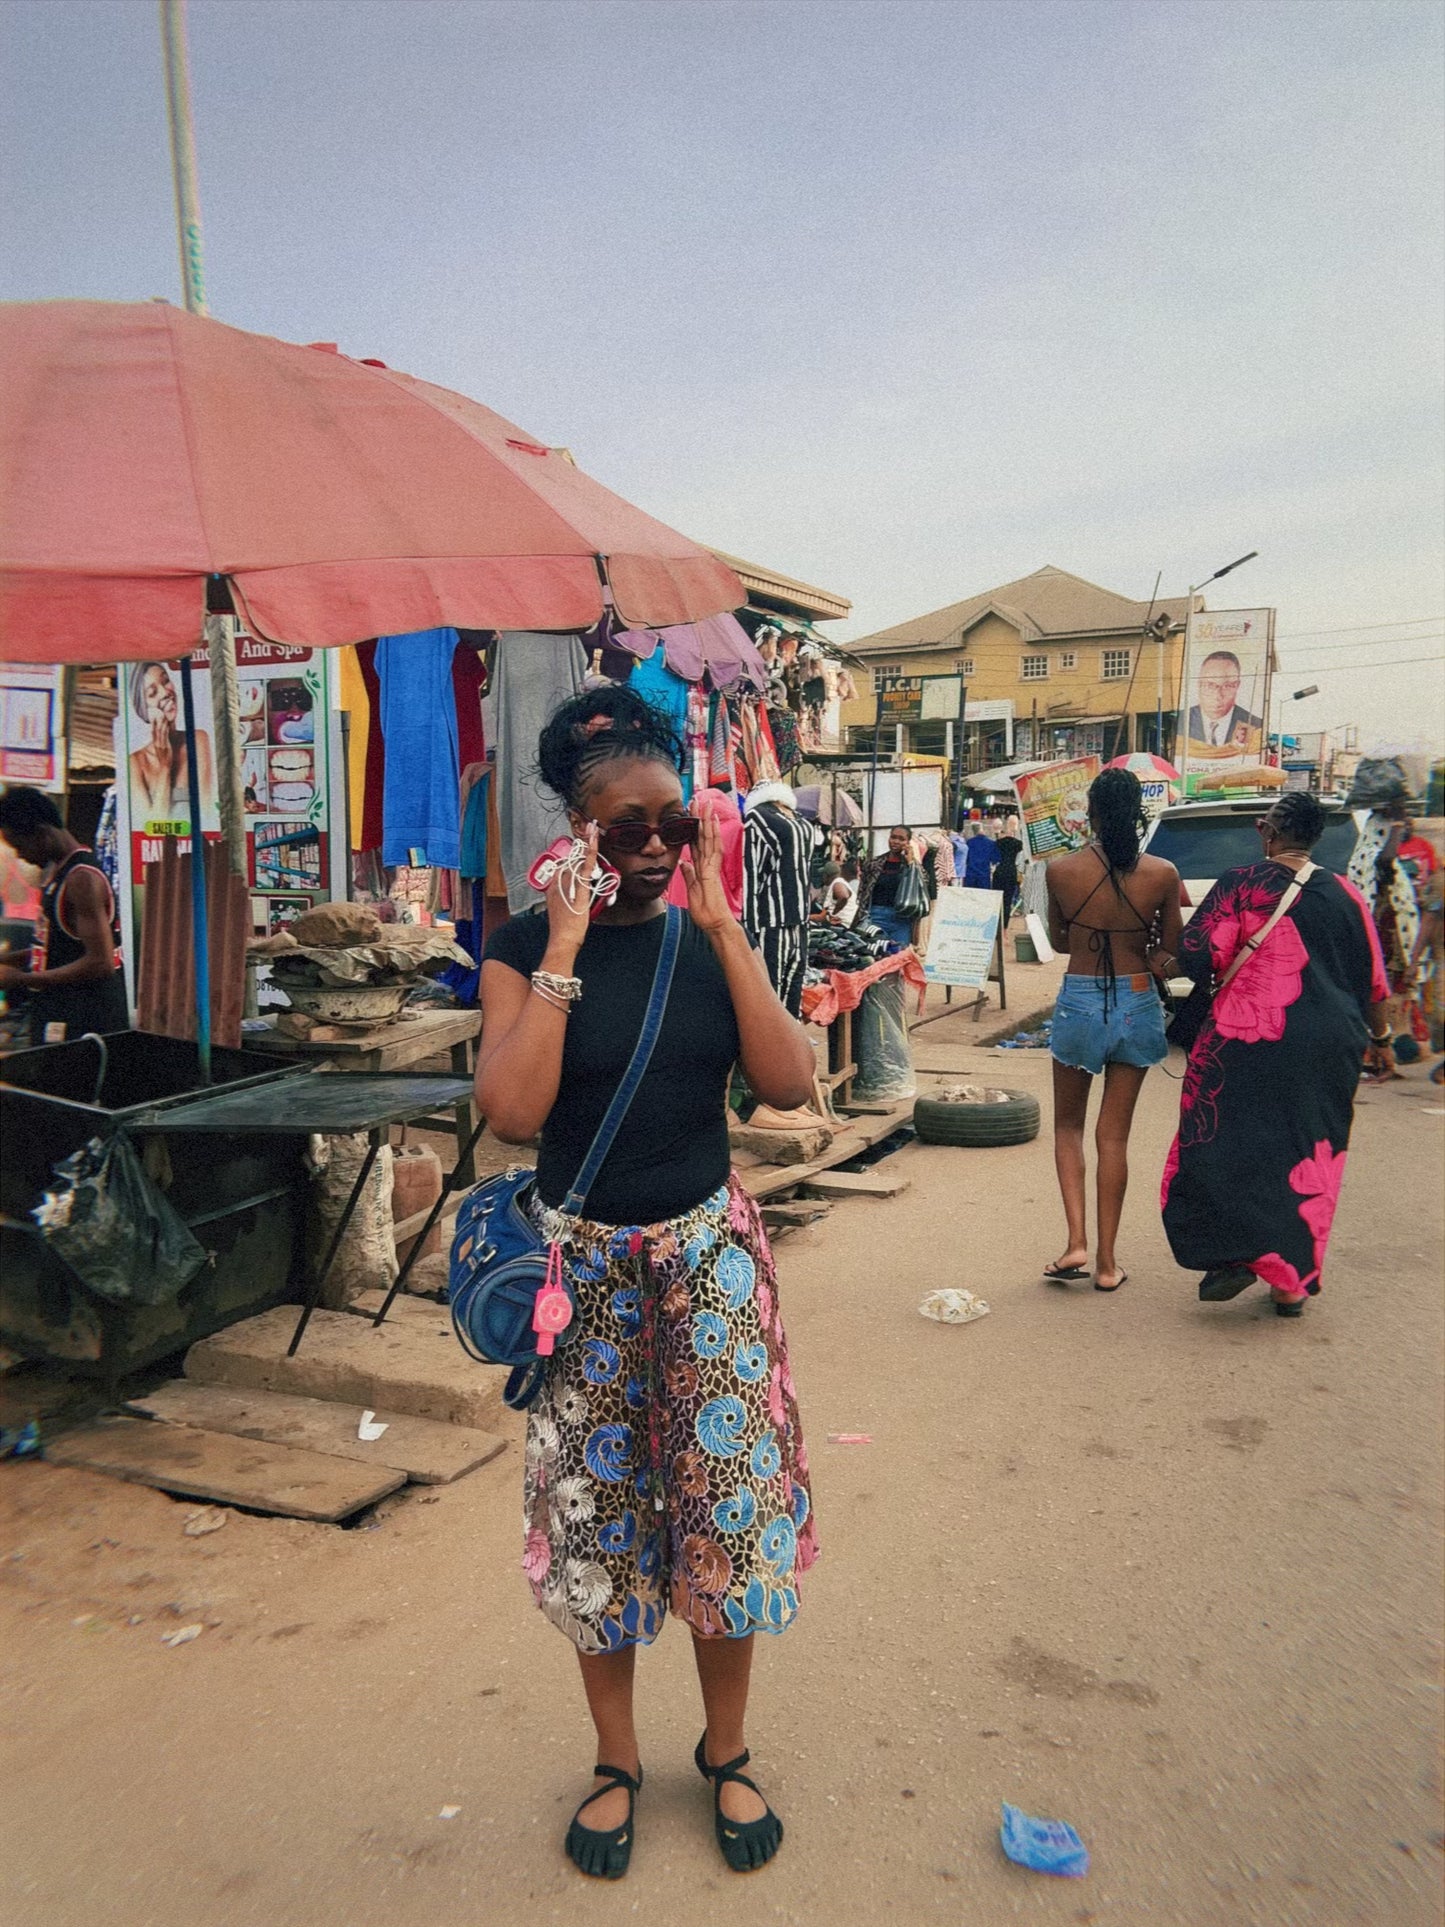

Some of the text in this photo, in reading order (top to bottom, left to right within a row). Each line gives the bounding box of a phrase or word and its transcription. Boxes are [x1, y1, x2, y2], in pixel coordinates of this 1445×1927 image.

[241, 640, 304, 660] And Spa
[885, 678, 921, 692] I.C.U
[1142, 784, 1164, 798] HOP
